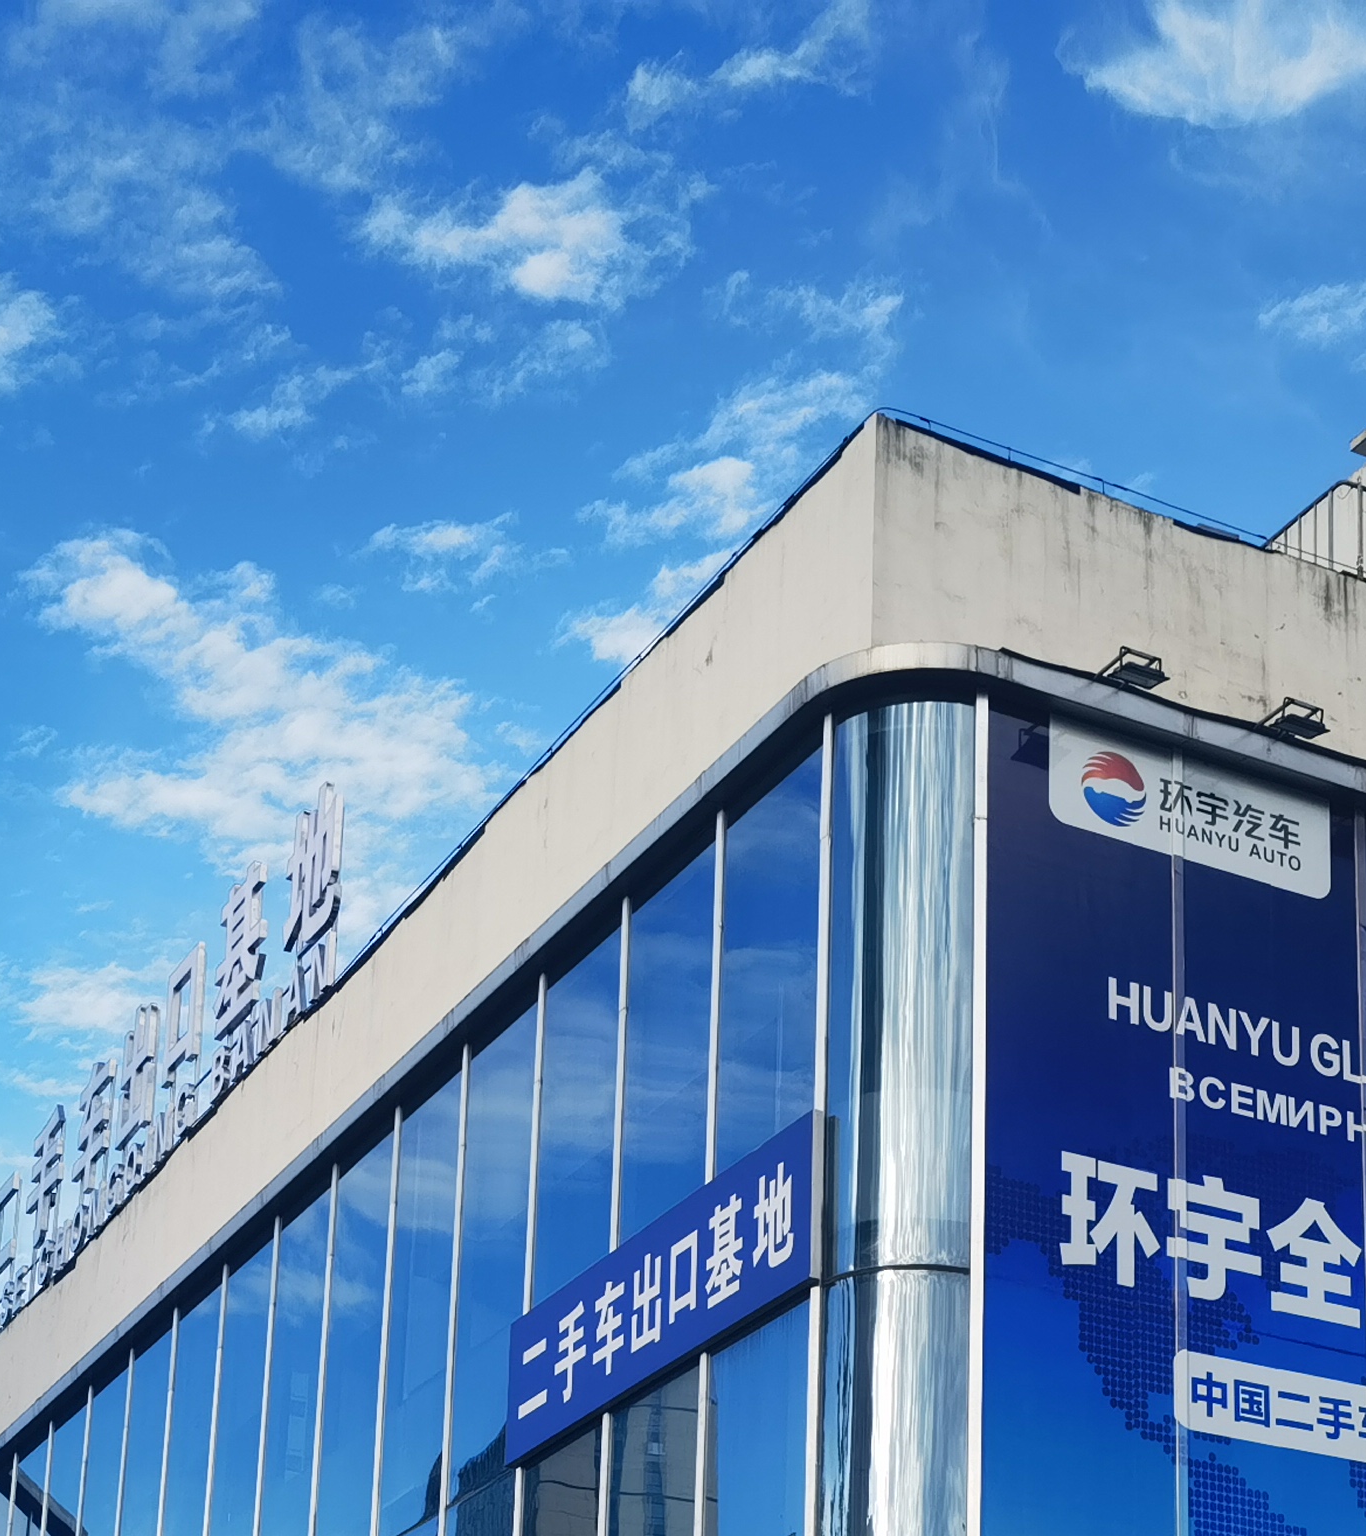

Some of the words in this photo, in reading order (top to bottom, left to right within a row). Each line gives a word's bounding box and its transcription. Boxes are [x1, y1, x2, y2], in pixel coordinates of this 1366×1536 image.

[1159, 778, 1301, 849] 环宇汽车
[1159, 815, 1239, 852] HUANYU
[1249, 843, 1301, 872] AUTO
[210, 930, 337, 1104] BANAN
[1107, 976, 1300, 1067] HUANYU
[517, 1161, 795, 1421] 二手车出口基地
